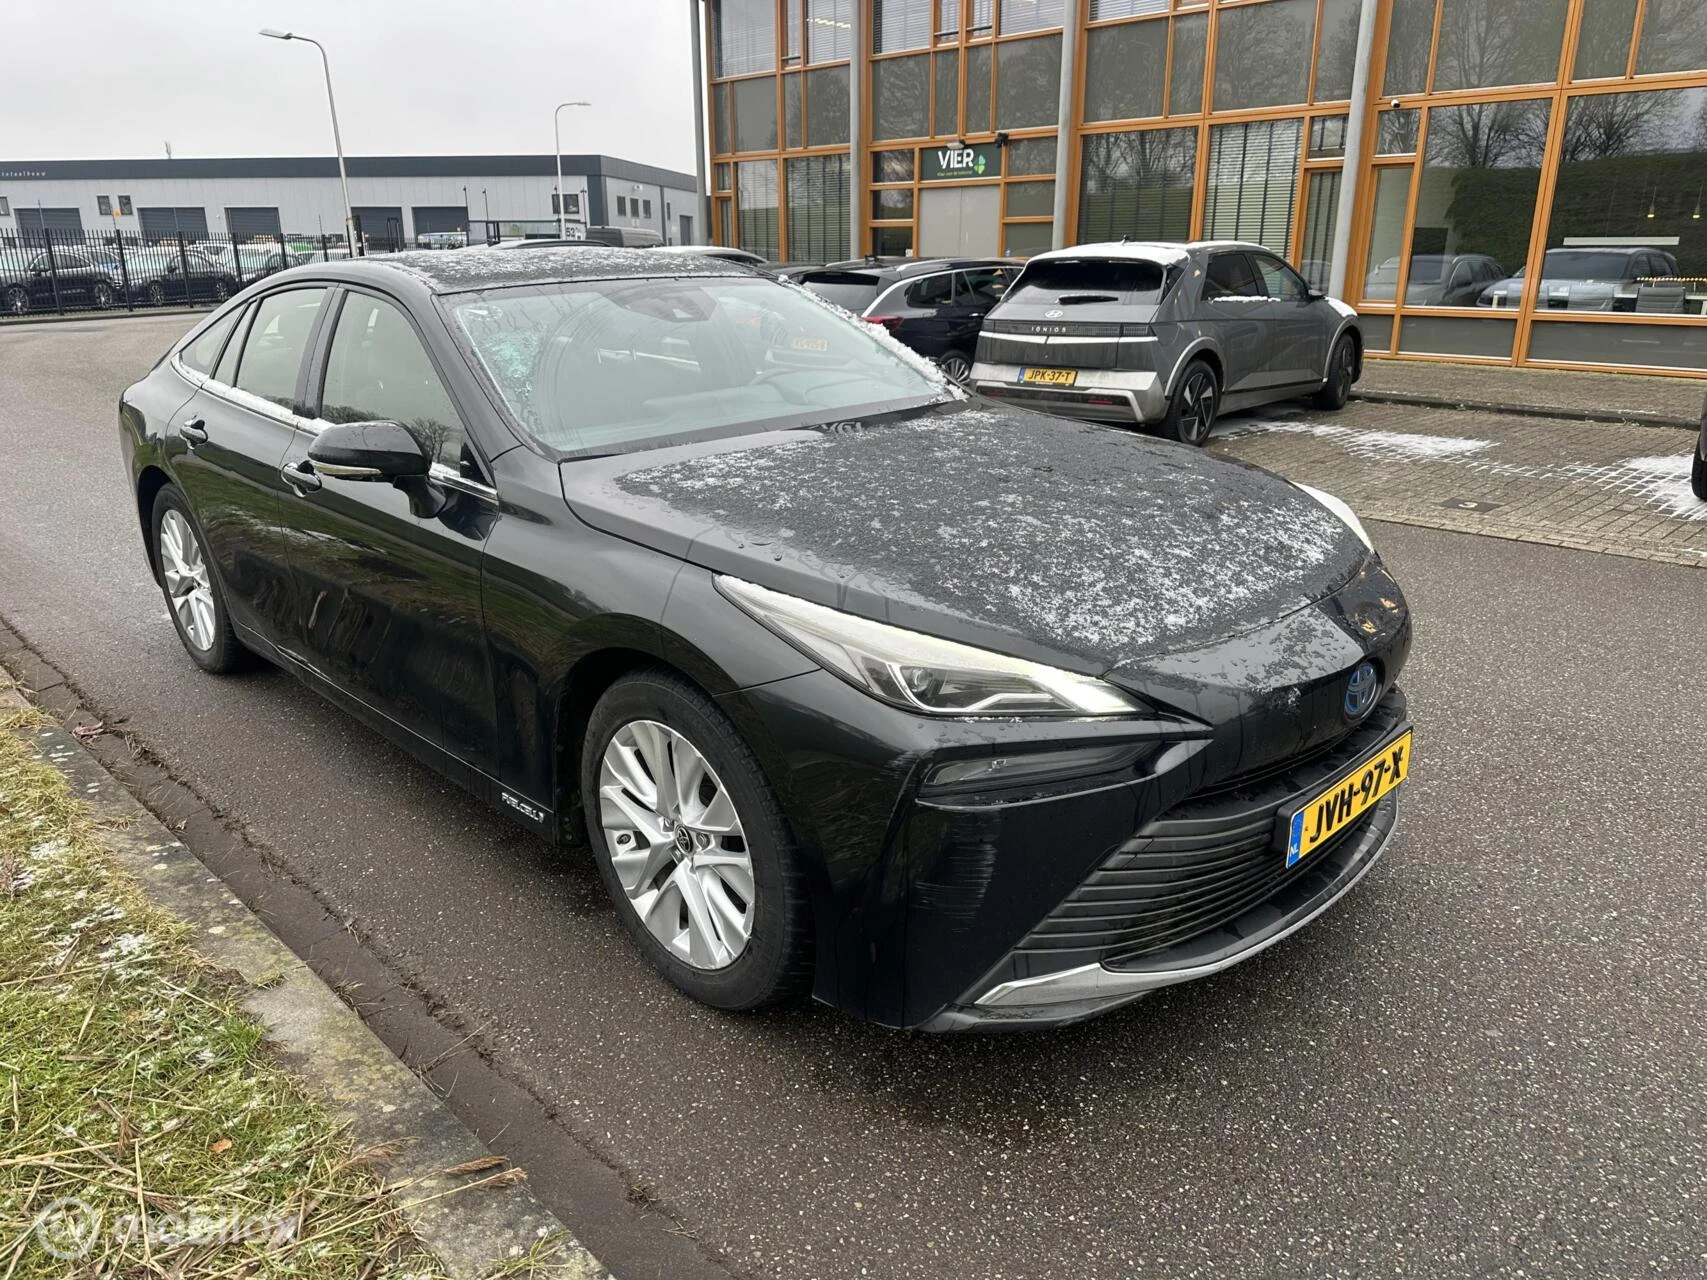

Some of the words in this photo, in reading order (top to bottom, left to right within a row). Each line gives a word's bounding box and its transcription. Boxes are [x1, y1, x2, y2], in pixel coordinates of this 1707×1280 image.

[938, 148, 974, 169] VIER
[1028, 370, 1071, 381] JPK-37-T
[1309, 746, 1404, 843] JVH-97-X
